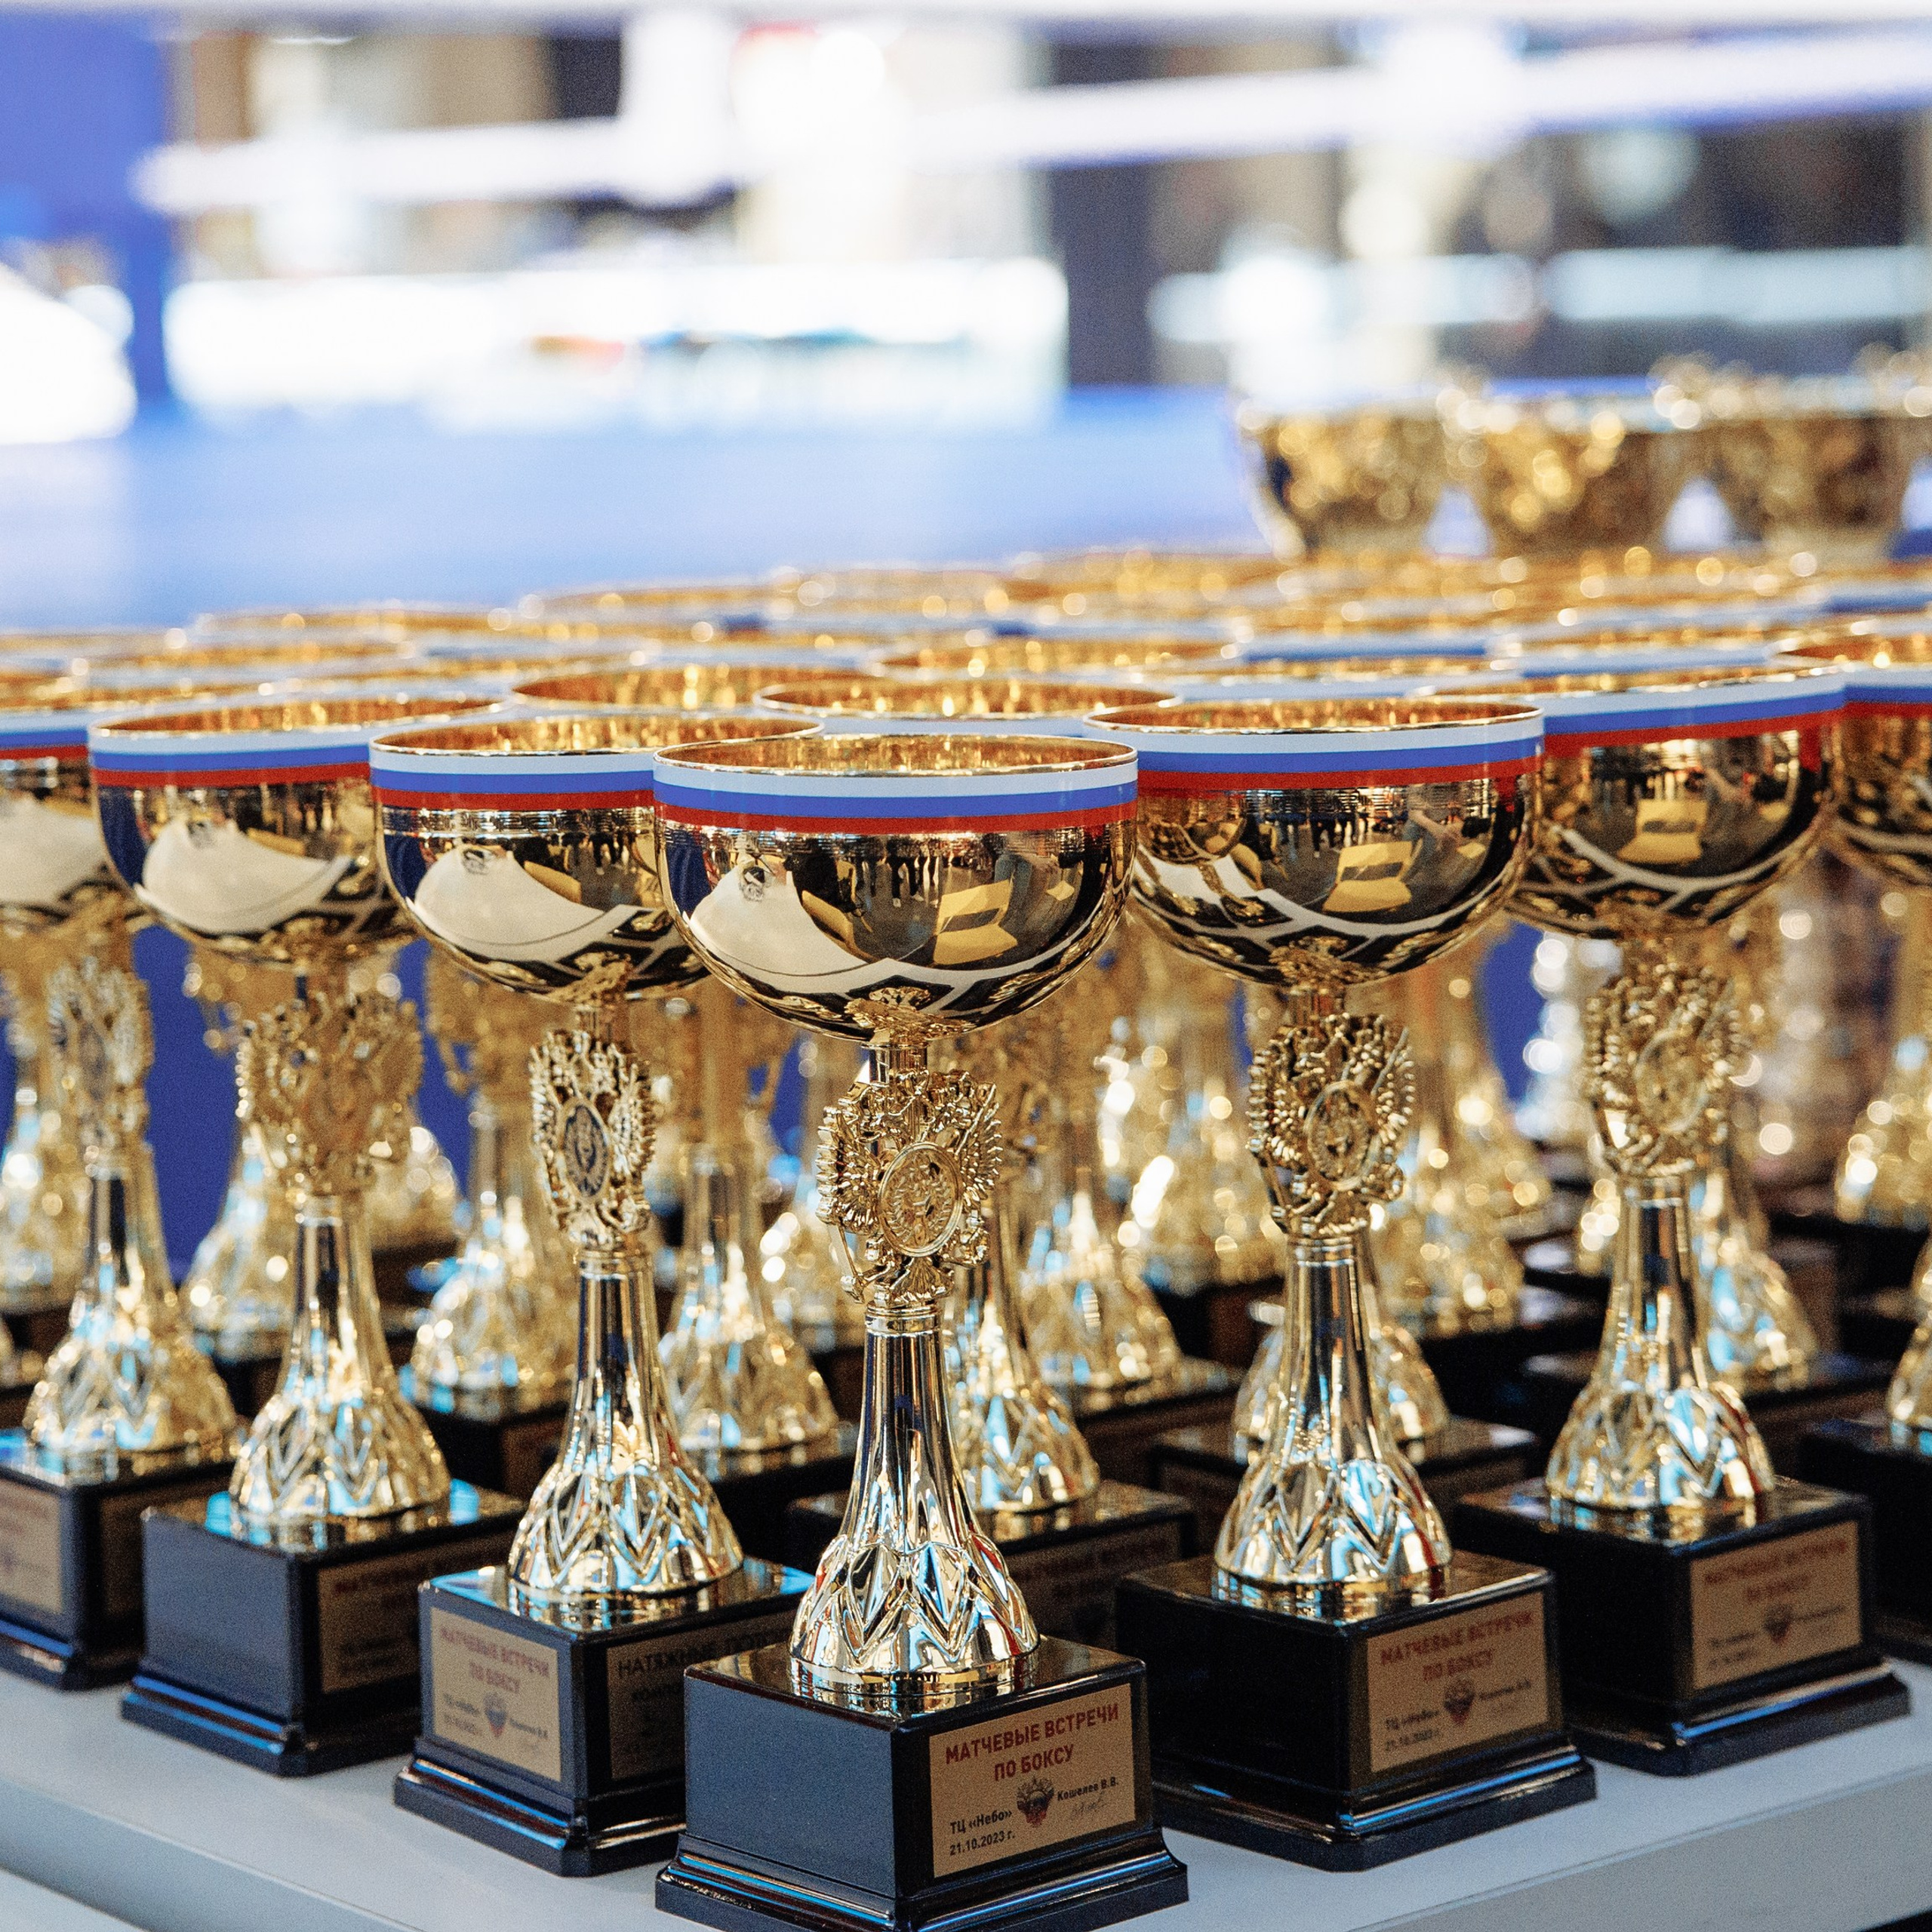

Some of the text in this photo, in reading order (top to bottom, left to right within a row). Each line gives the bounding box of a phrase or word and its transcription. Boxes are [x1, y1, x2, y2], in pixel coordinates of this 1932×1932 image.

[1380, 1628, 1464, 1666] МАТЧЕВЫЕ
[946, 1703, 1118, 1764] МАТЧЕВЫЕ ВСТРЕЧИ
[994, 1744, 1074, 1782] ПО БОКСУ
[1057, 1783, 1098, 1801] Кошелев
[950, 1809, 1012, 1835] ТЦ «Небо»
[949, 1830, 1016, 1857] 21.10.2023 г.
